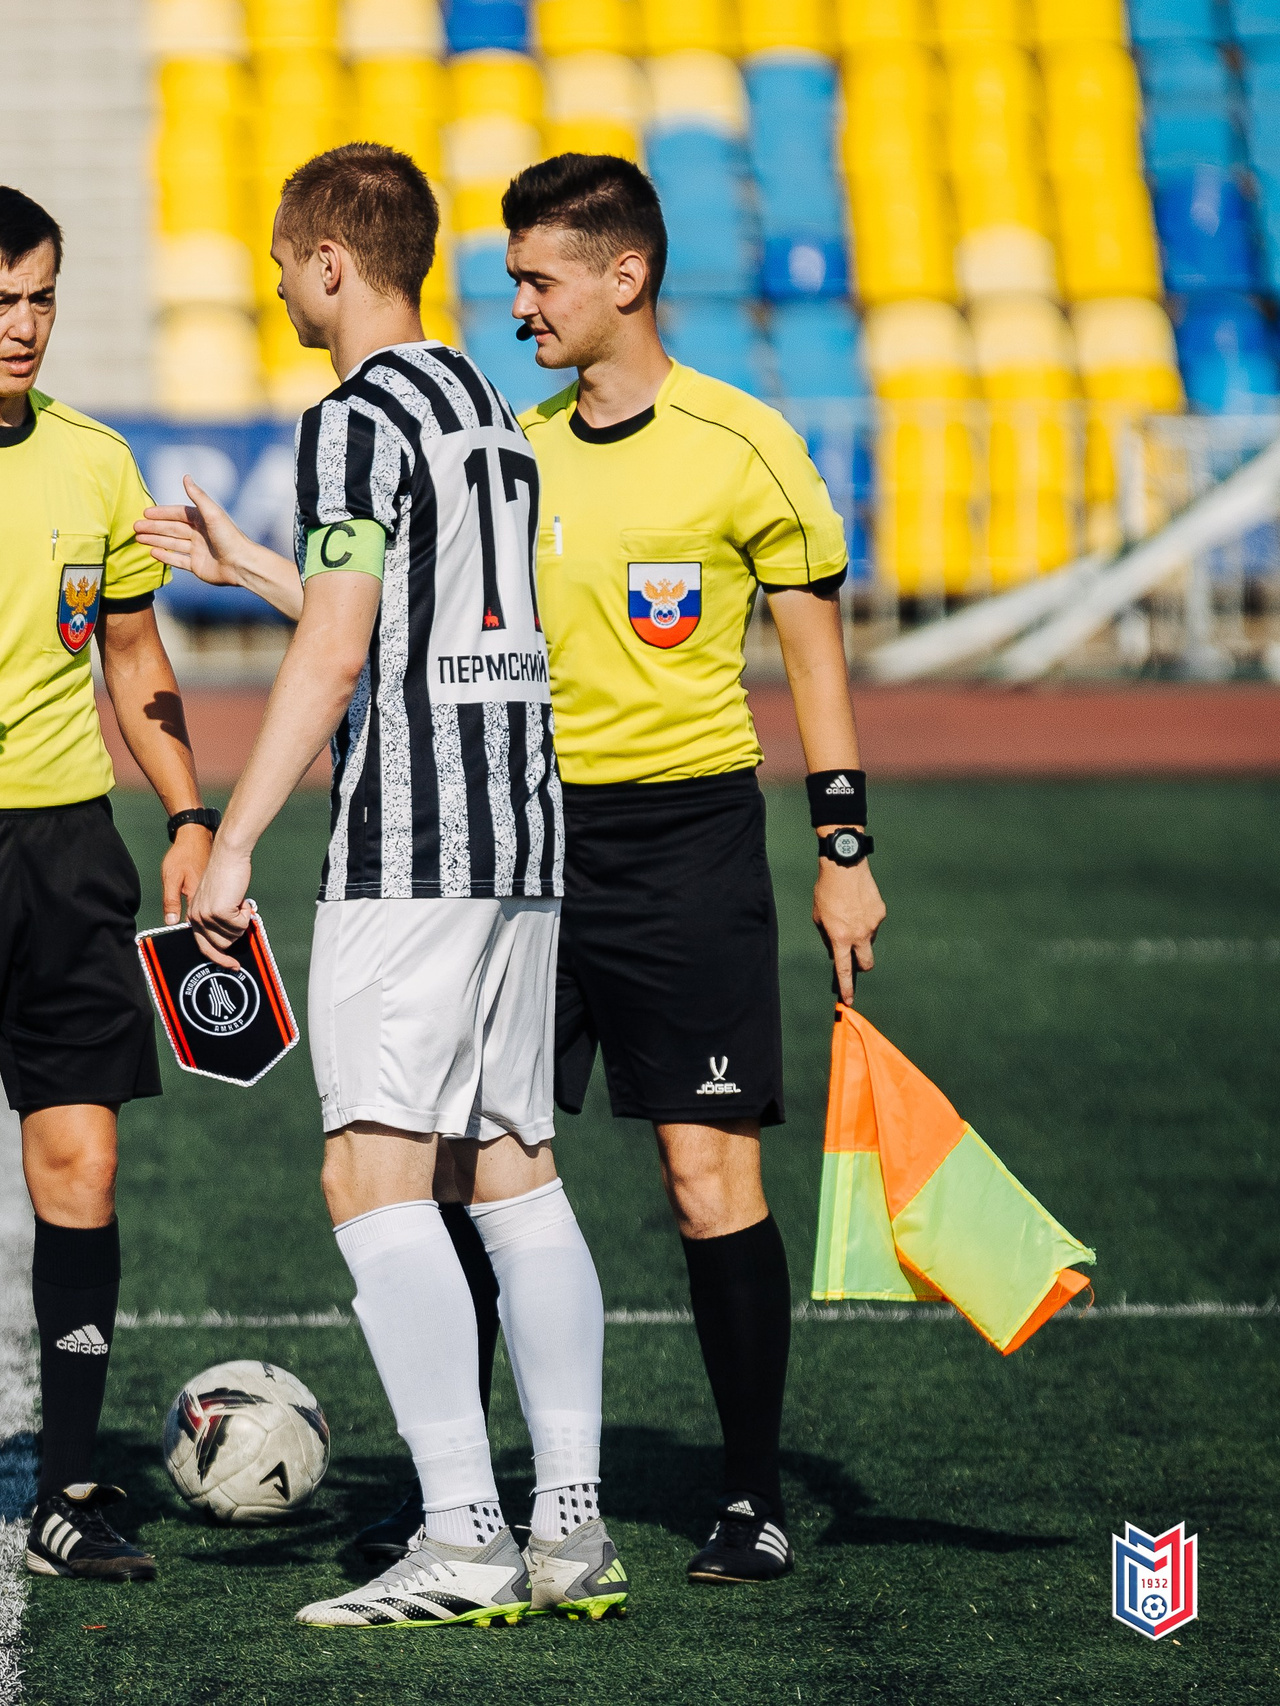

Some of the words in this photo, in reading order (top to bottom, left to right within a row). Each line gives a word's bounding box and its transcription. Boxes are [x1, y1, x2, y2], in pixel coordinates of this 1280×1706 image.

[321, 521, 356, 568] C
[464, 447, 543, 633] 17
[437, 650, 548, 684] ПЕРМСКИЙ
[825, 787, 855, 795] adidas
[184, 967, 211, 996] АКАДЕМИЯ
[214, 1018, 244, 1032] АМКАР
[696, 1081, 742, 1095] JÖGEL
[56, 1338, 109, 1356] adidas
[727, 1505, 756, 1517] adidas
